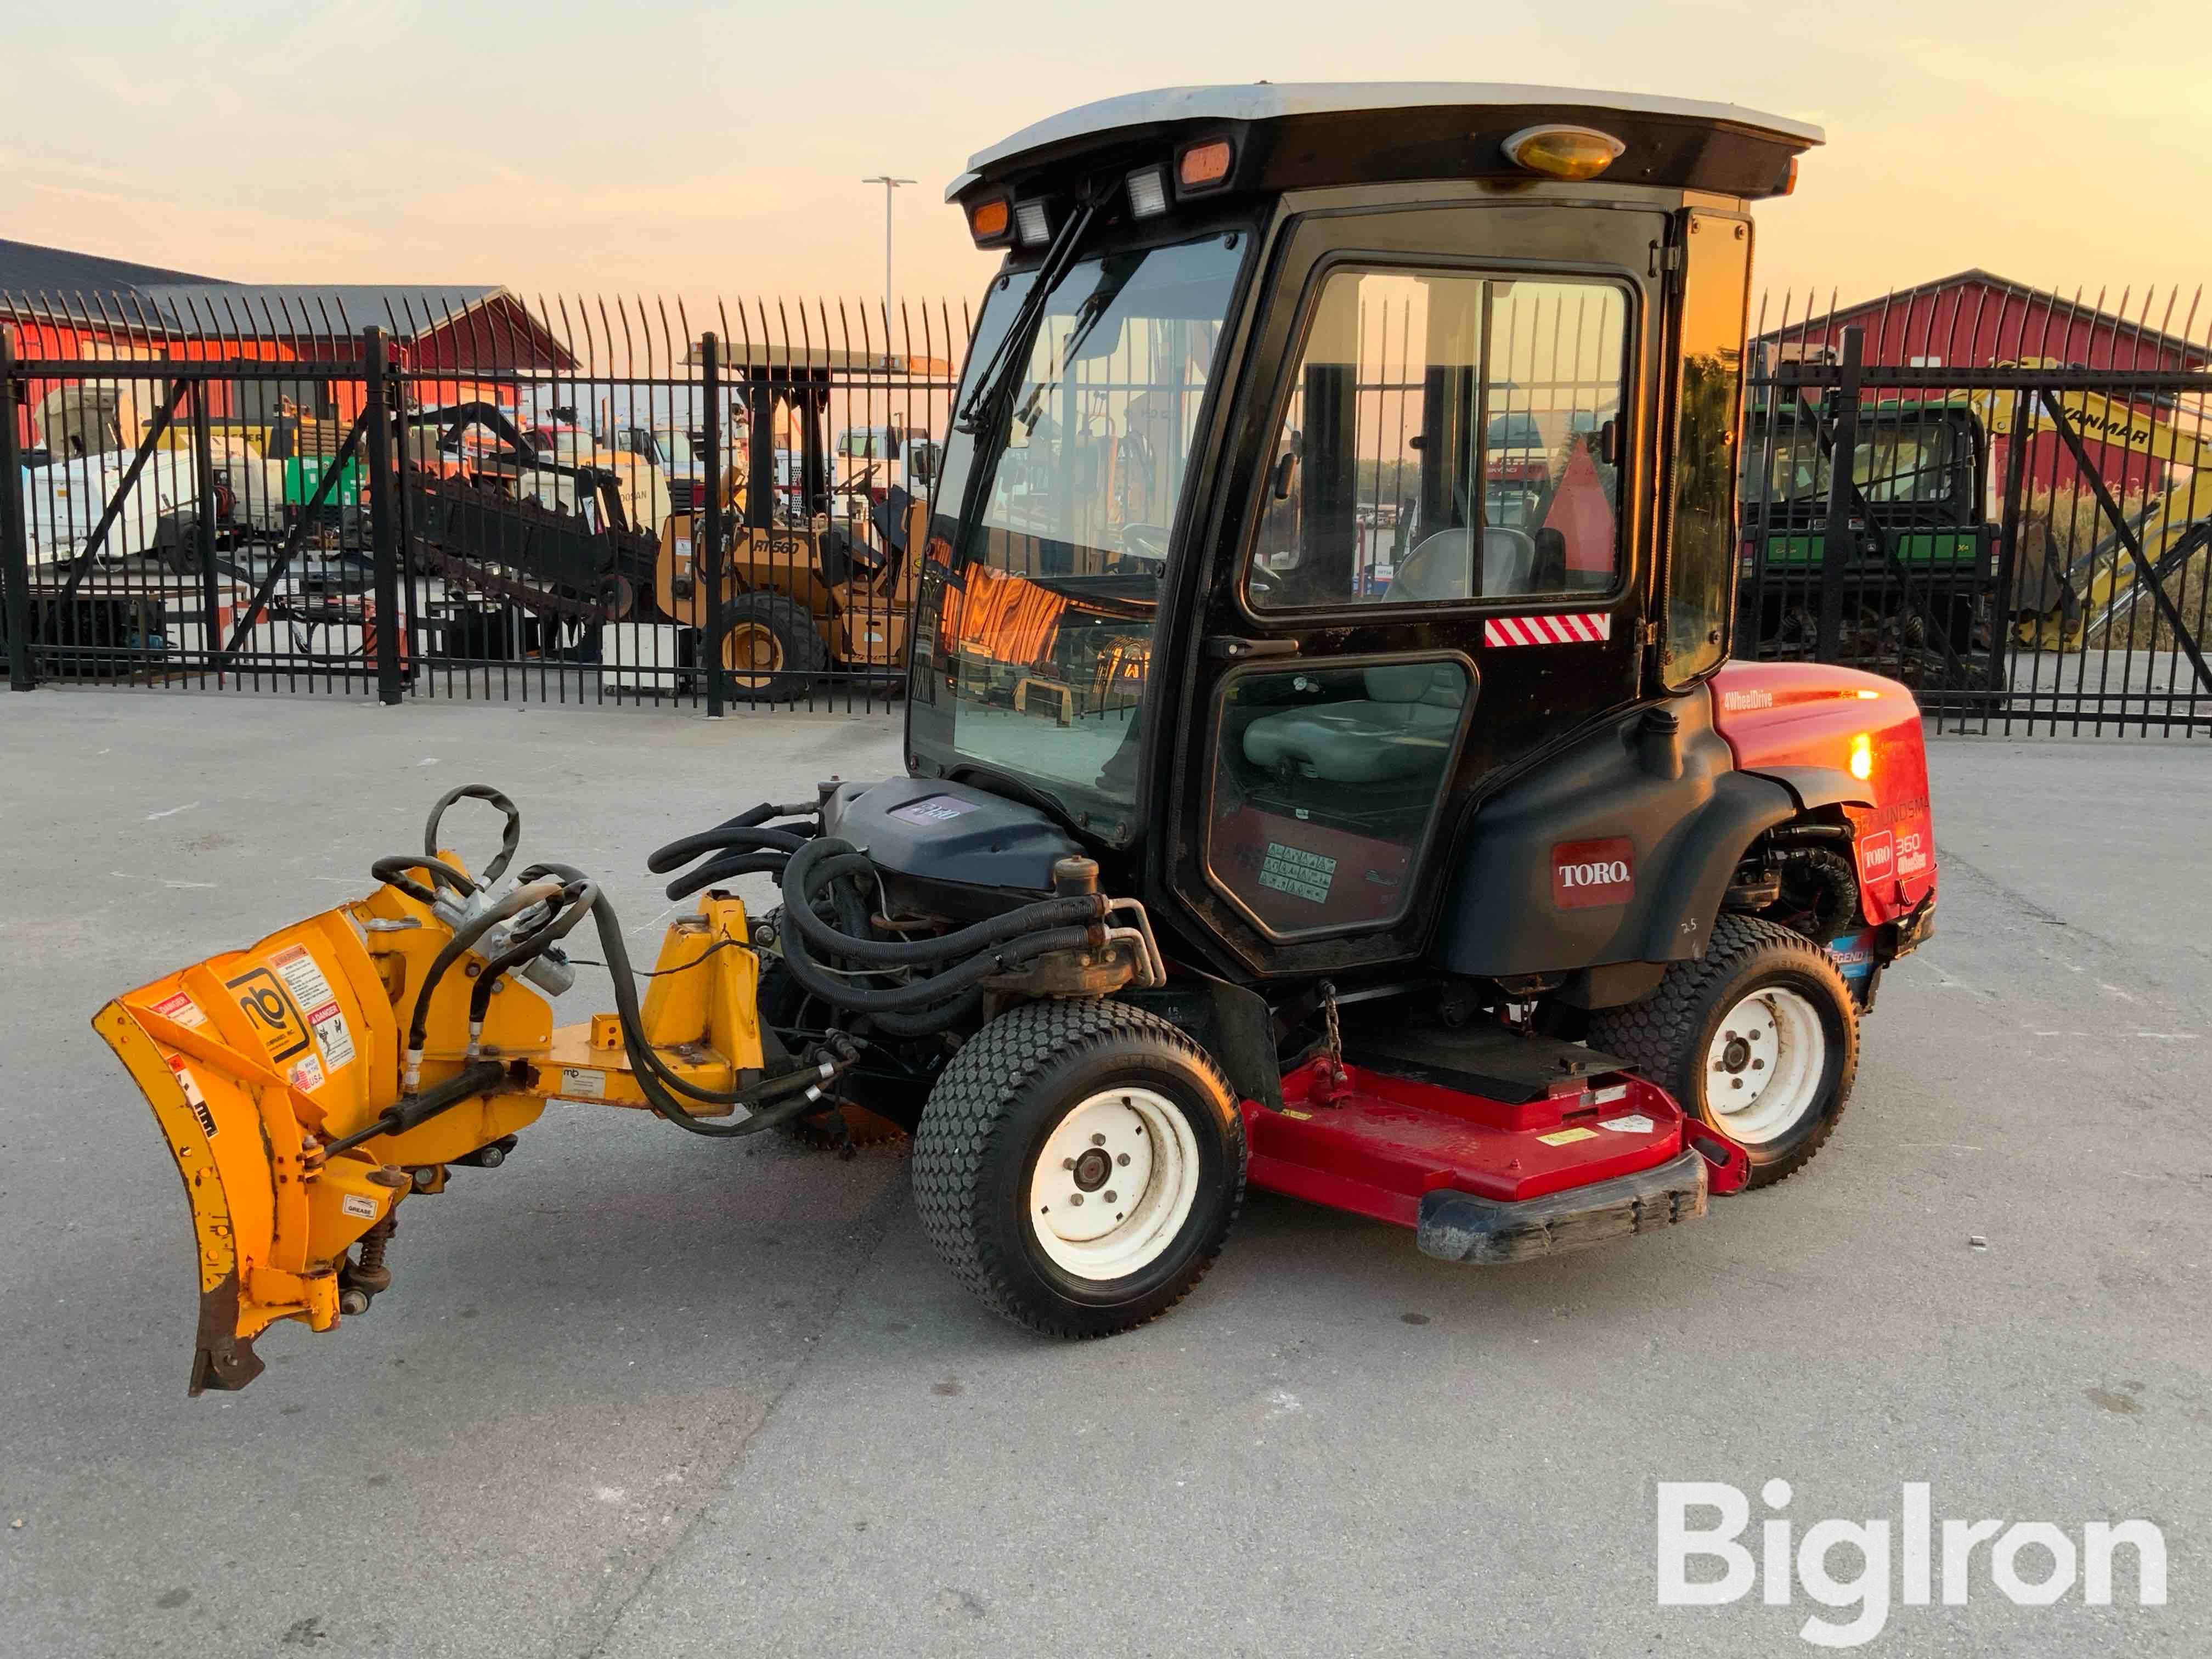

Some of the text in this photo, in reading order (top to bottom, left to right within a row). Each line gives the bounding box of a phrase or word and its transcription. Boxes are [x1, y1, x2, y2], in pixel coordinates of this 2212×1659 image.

[1725, 690, 1773, 711] 4WheelDrive
[1896, 833, 1920, 856] 360
[1865, 845, 1891, 868] TORO
[315, 1003, 338, 1022] DANGER
[309, 1074, 323, 1086] USA
[348, 1206, 372, 1215] GREASE
